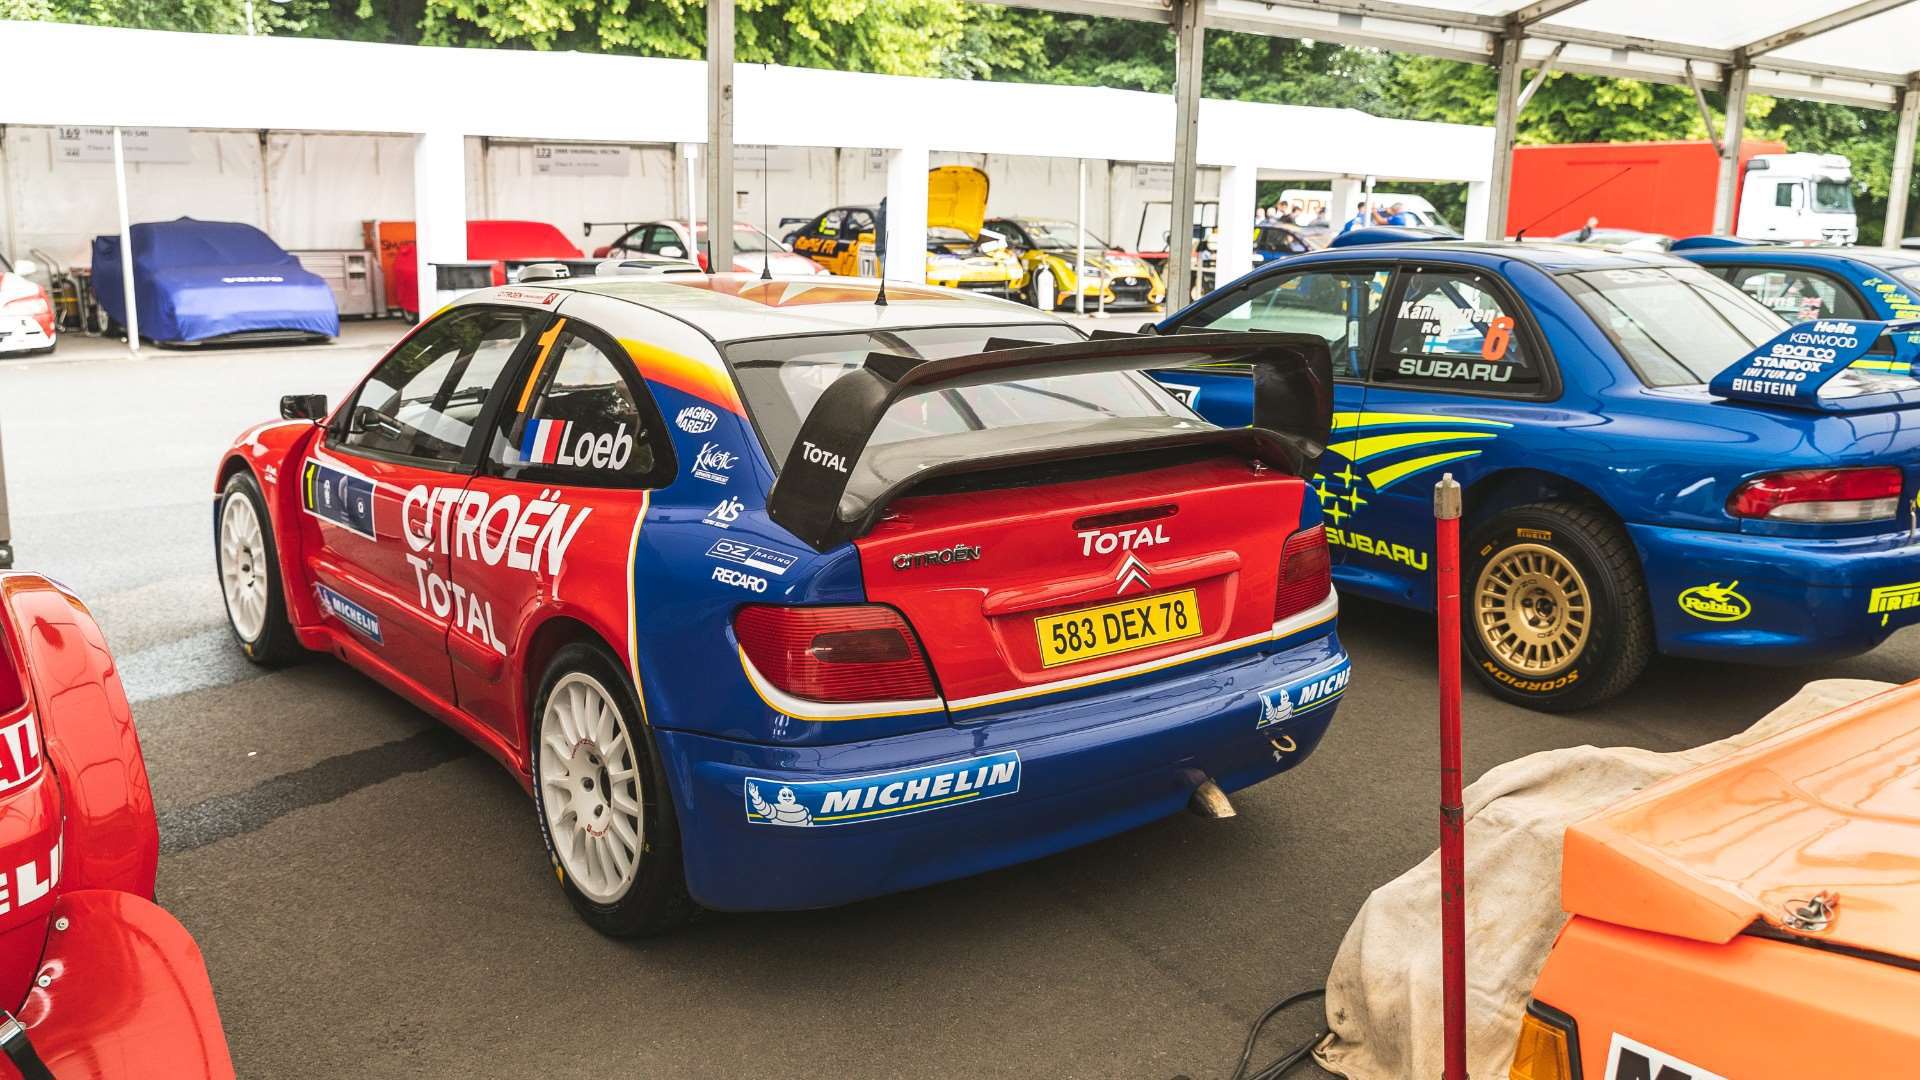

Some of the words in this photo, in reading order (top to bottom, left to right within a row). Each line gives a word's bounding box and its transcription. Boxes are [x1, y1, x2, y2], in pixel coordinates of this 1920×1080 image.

[1482, 316, 1515, 361] 6
[1789, 333, 1858, 349] KENWOOD
[1813, 321, 1857, 335] Hella
[516, 318, 568, 413] 1
[1752, 356, 1822, 373] STANDOX
[1771, 343, 1837, 361] sparco
[1398, 358, 1513, 382] SUBARU
[1742, 367, 1763, 379] IHI
[1764, 369, 1807, 382] TURBO
[1732, 378, 1797, 397] BILSTEIN
[557, 420, 633, 470] Loeb
[691, 441, 739, 474] Kinetic
[803, 441, 847, 473] TOTAL
[402, 488, 593, 576] CITROËN
[1077, 524, 1171, 557] TOTAL
[1517, 528, 1552, 540] PIRELLI
[754, 551, 791, 565] RACING
[892, 543, 981, 570] CITROËN
[1325, 527, 1427, 571] SUBARU
[711, 567, 768, 593] RECARO
[332, 597, 379, 636] MICHELIN
[405, 552, 507, 656] TOTAL
[1686, 597, 1741, 616] Robin
[1052, 618, 1097, 655] 583
[1102, 605, 1156, 645] DEX
[1159, 599, 1188, 633] 78
[1482, 661, 1580, 692] SCORPION
[820, 761, 1016, 814] MICHELIN
